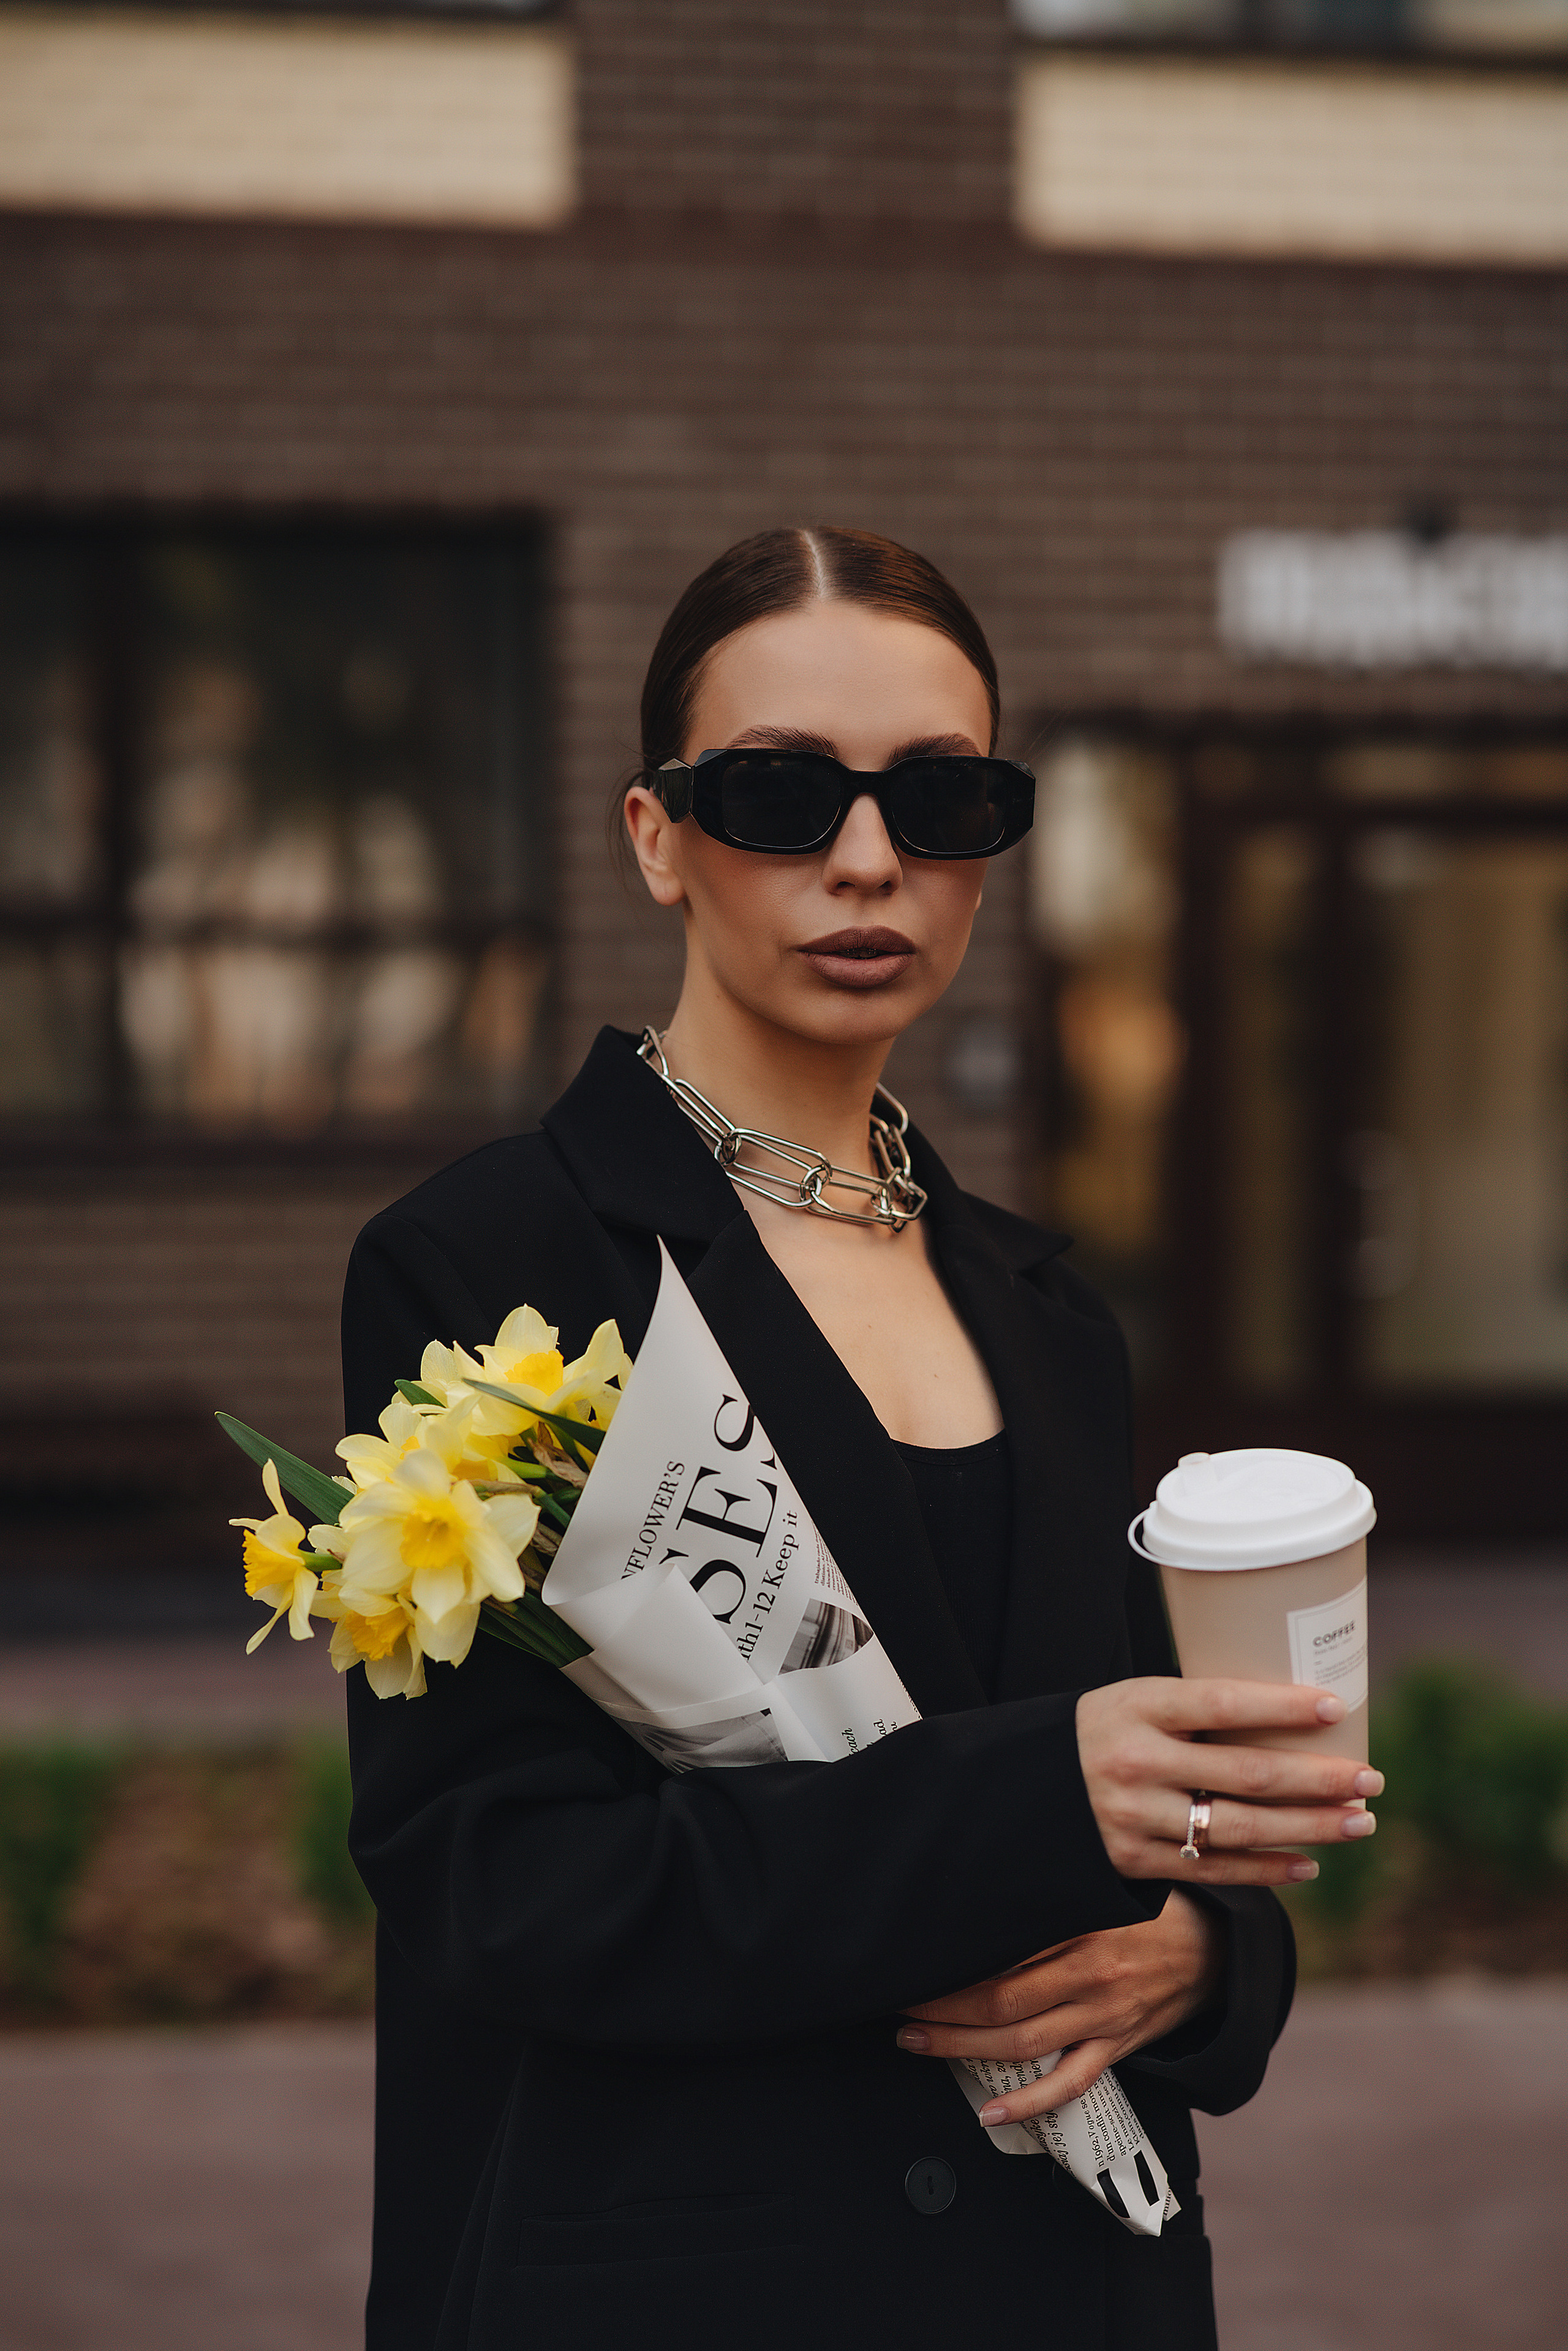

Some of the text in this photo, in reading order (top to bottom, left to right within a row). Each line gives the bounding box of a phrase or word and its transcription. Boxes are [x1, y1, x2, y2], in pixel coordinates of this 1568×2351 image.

[761, 1533, 800, 1590] Keep
[782, 1510, 798, 1528] it
[1313, 1620, 1355, 1648] COFFEE
[1103, 2071, 1116, 2091] pour
[1080, 2099, 1088, 2109] se
[1097, 2090, 1107, 2107] une
[1044, 2110, 1058, 2129] sty
[1108, 2096, 1129, 2138] magazine
[1096, 2113, 1110, 2141] conflit
[1047, 2132, 1066, 2147] jej
[1106, 2142, 1115, 2161] d'un
